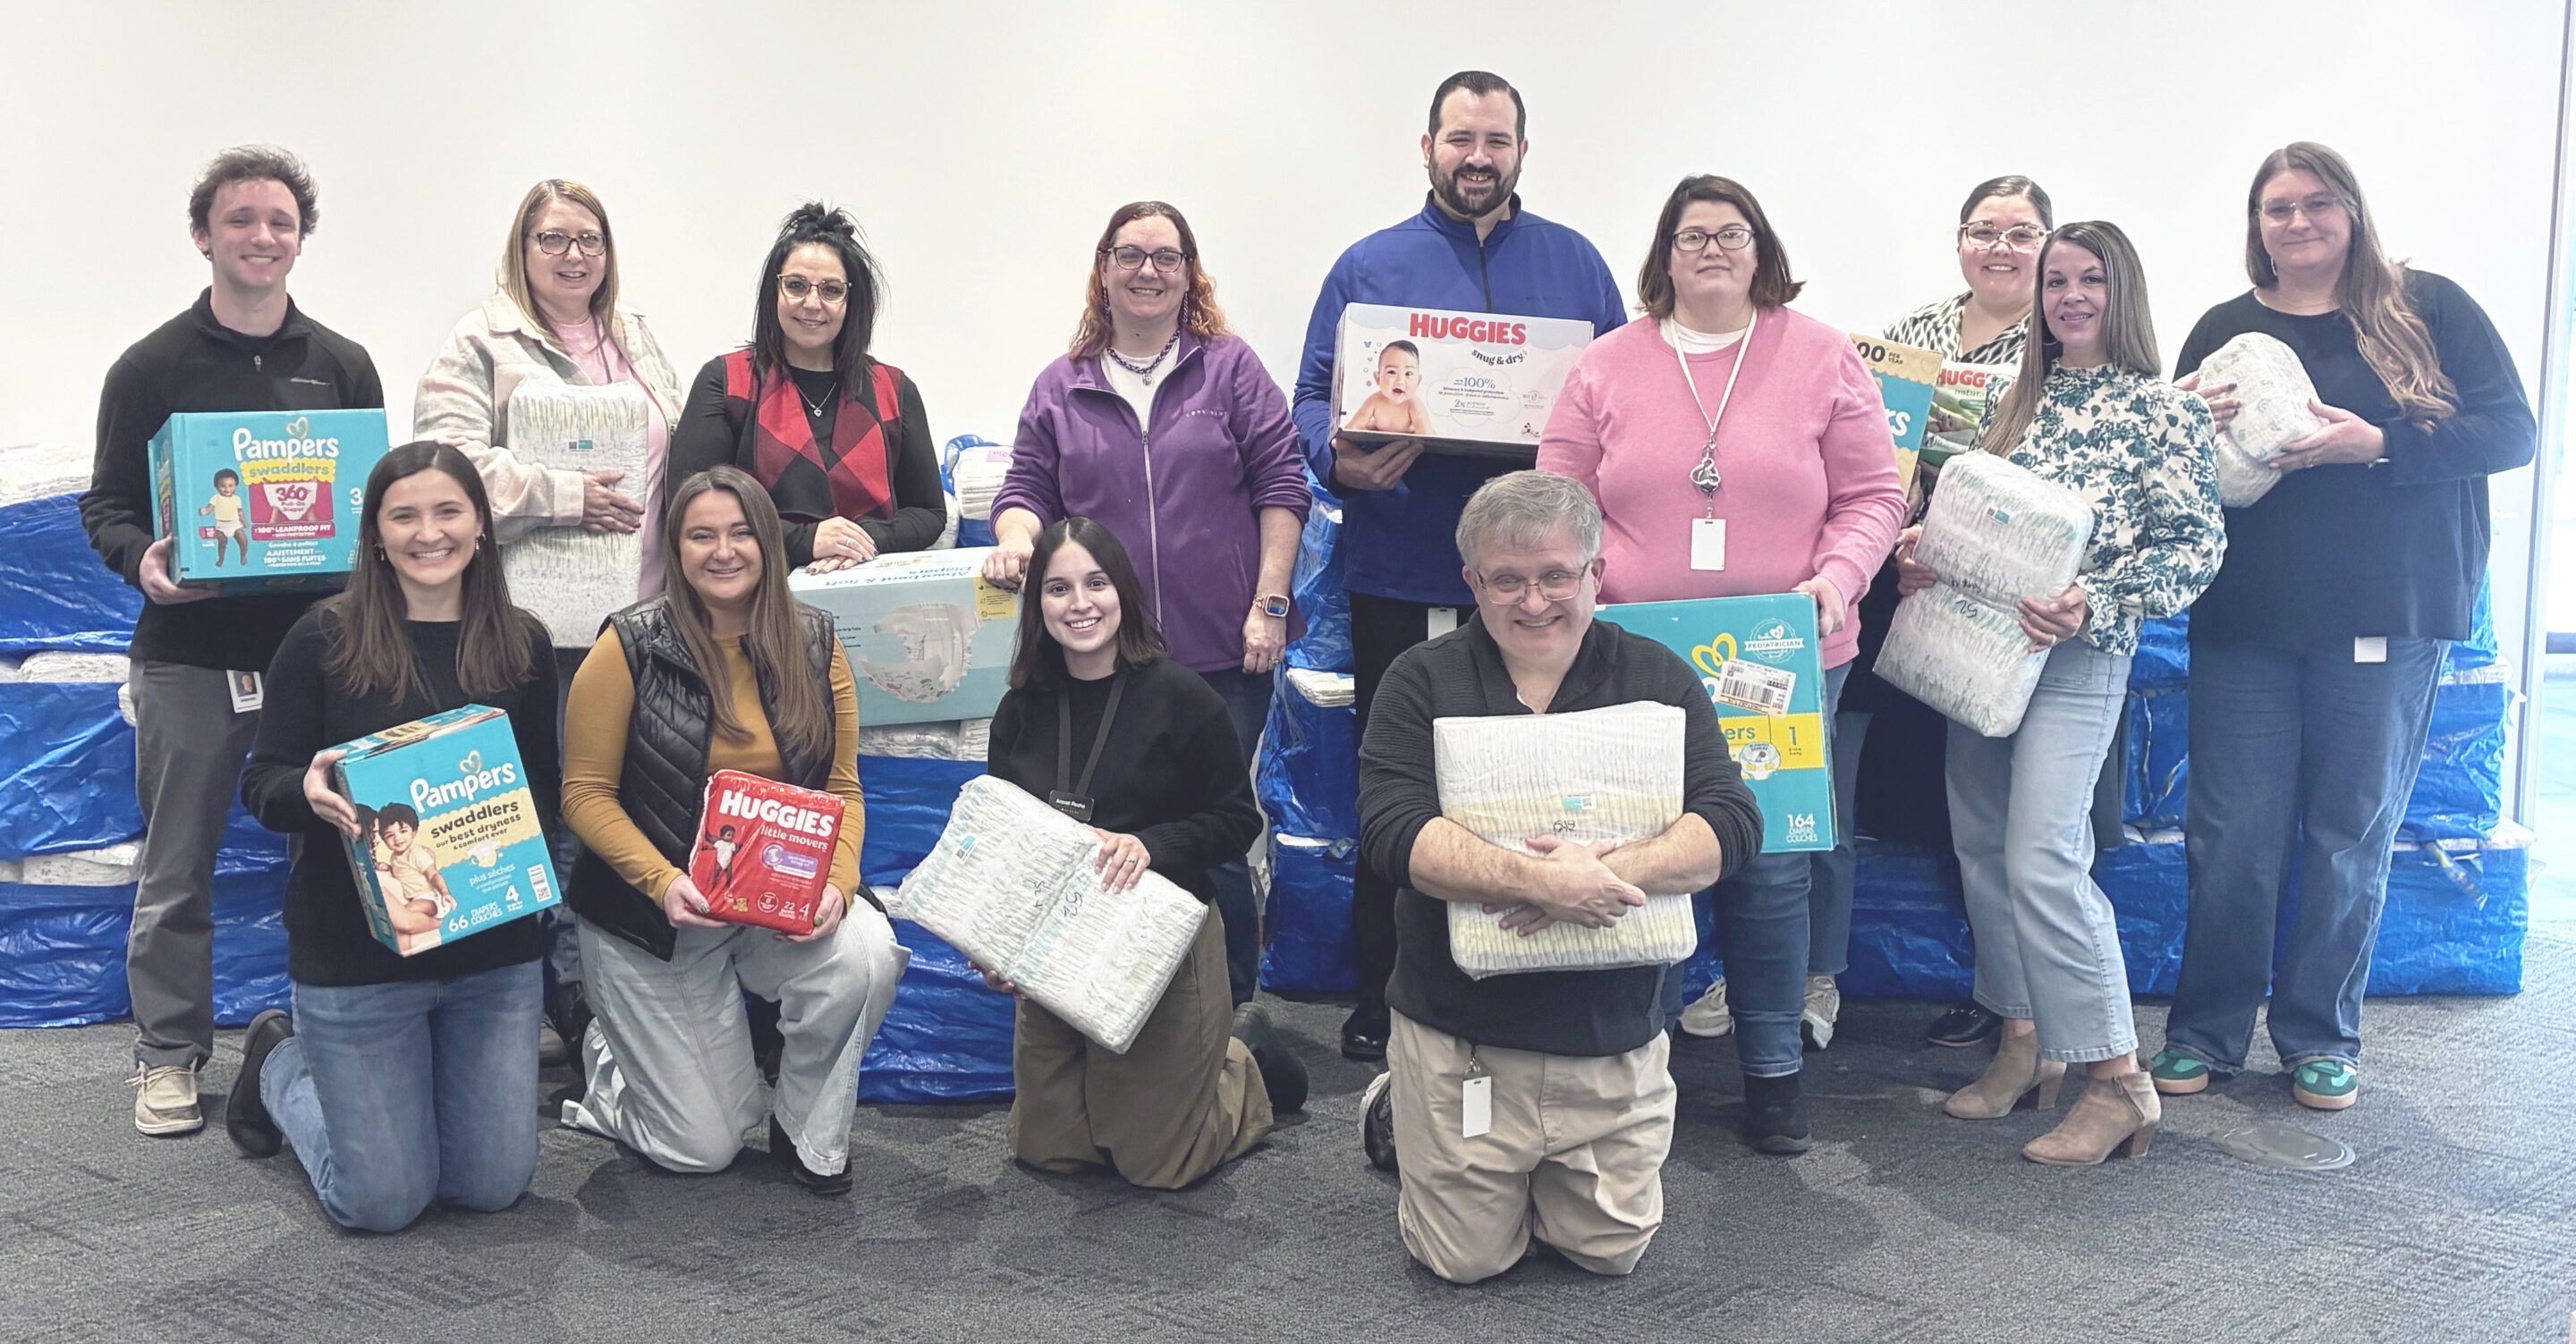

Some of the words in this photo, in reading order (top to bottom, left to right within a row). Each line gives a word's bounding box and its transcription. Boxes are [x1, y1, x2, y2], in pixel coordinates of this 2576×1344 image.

[1410, 313, 1526, 345] HUGGIES
[1471, 350, 1496, 366] snug
[1496, 356, 1504, 365] &
[1505, 352, 1523, 365] dry
[1463, 376, 1496, 389] 100%
[1936, 368, 1990, 388] HUGG
[1954, 389, 1985, 398] natura
[233, 427, 339, 462] Pampers
[250, 462, 329, 478] swaddlers
[350, 487, 363, 506] 3
[266, 548, 314, 556] AJUSTEMENT
[1748, 640, 1801, 649] PEDIATRICIAN
[1724, 727, 1756, 740] ers
[1788, 725, 1797, 746] 1
[410, 762, 516, 814] Pampers
[430, 801, 519, 839] swaddlers
[719, 790, 835, 837] HUGGIES
[1787, 813, 1816, 828] 164
[436, 840, 449, 849] our
[449, 828, 476, 843] best
[477, 814, 521, 834] dryness
[459, 833, 489, 849] comfort
[490, 828, 508, 838] ever
[761, 825, 787, 841] little
[788, 833, 828, 850] movers
[469, 874, 487, 887] plus
[505, 884, 520, 902] 4
[470, 901, 498, 917] DIAPERS
[784, 900, 795, 910] 22
[799, 902, 811, 917] 4
[448, 914, 469, 933] 66
[470, 908, 503, 926] COUCHES
